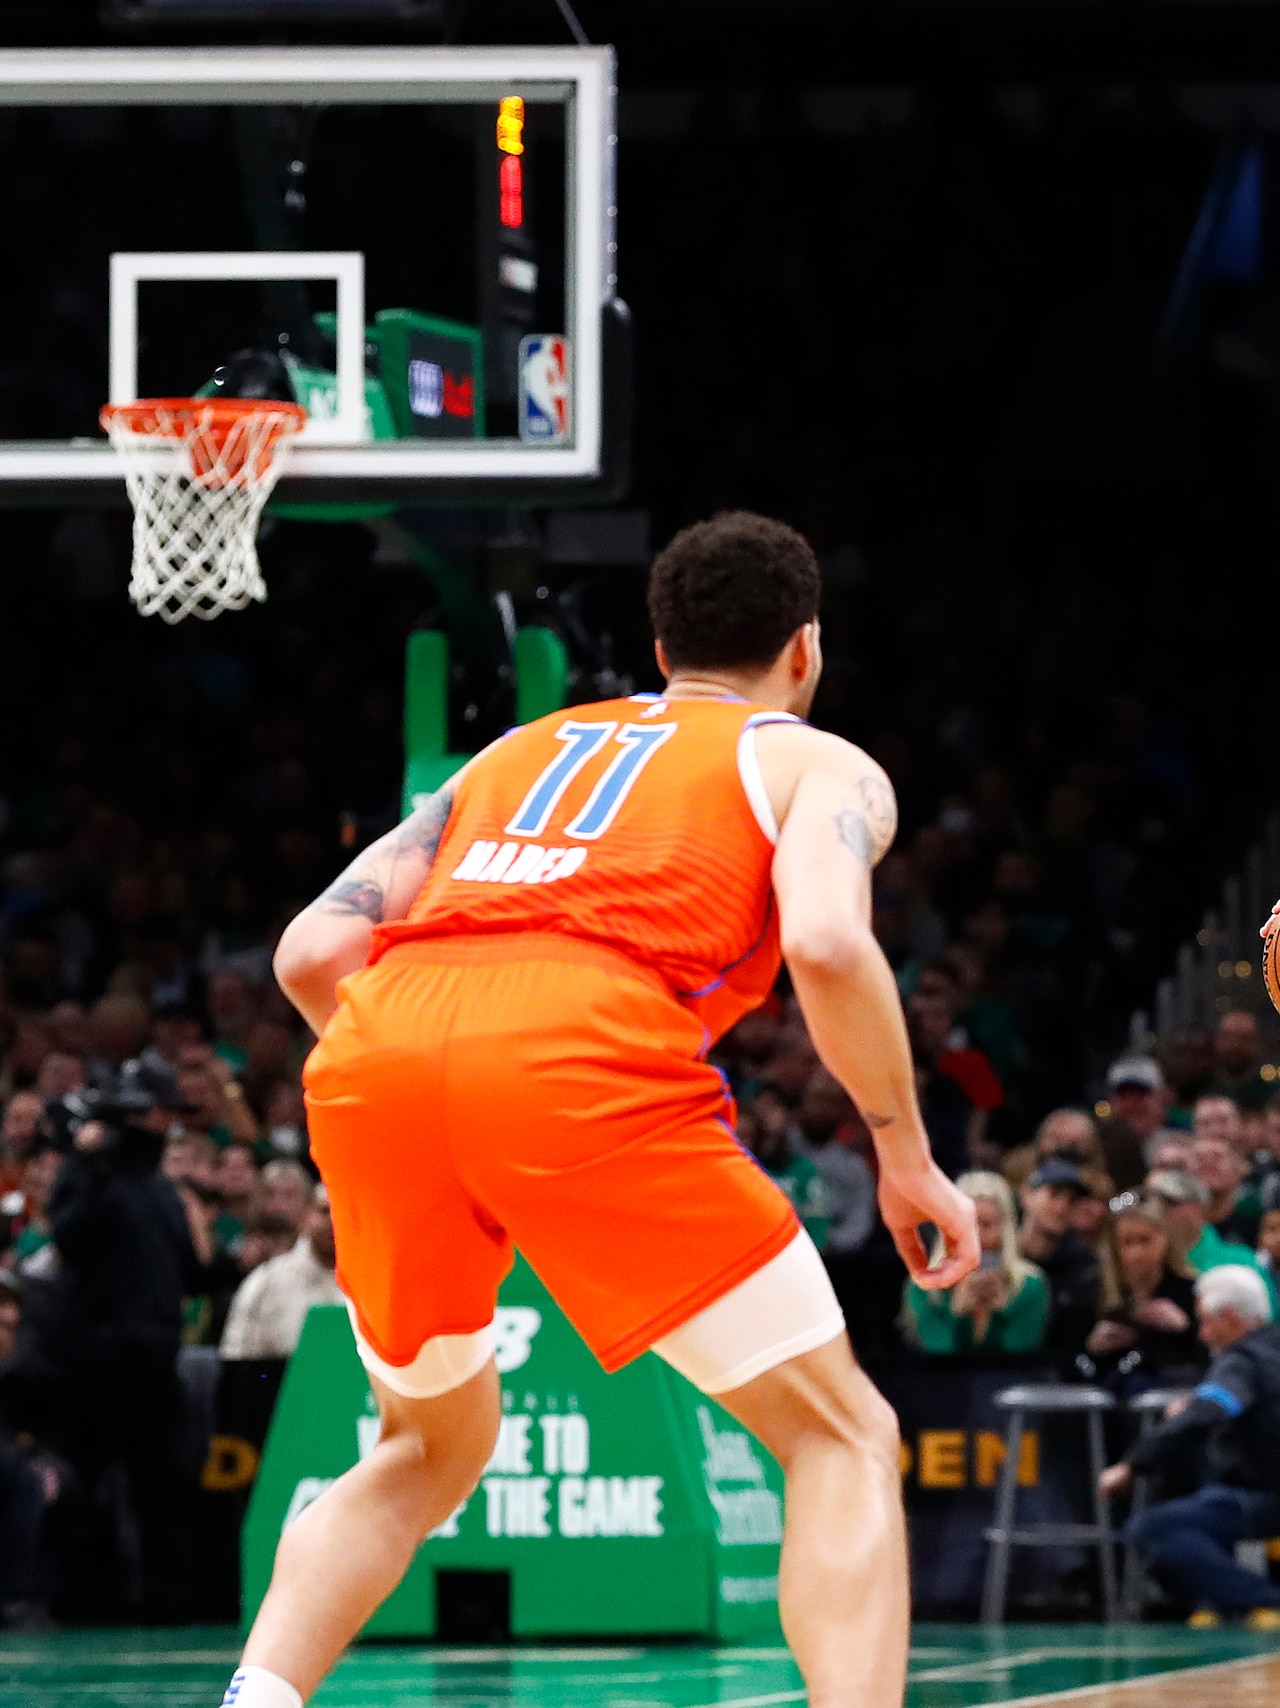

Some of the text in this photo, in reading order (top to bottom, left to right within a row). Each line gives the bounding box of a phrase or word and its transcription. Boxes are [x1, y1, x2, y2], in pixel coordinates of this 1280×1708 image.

[505, 721, 678, 839] 11
[538, 1413, 590, 1475] TO
[483, 1476, 551, 1538] THE
[558, 1476, 665, 1538] GAME
